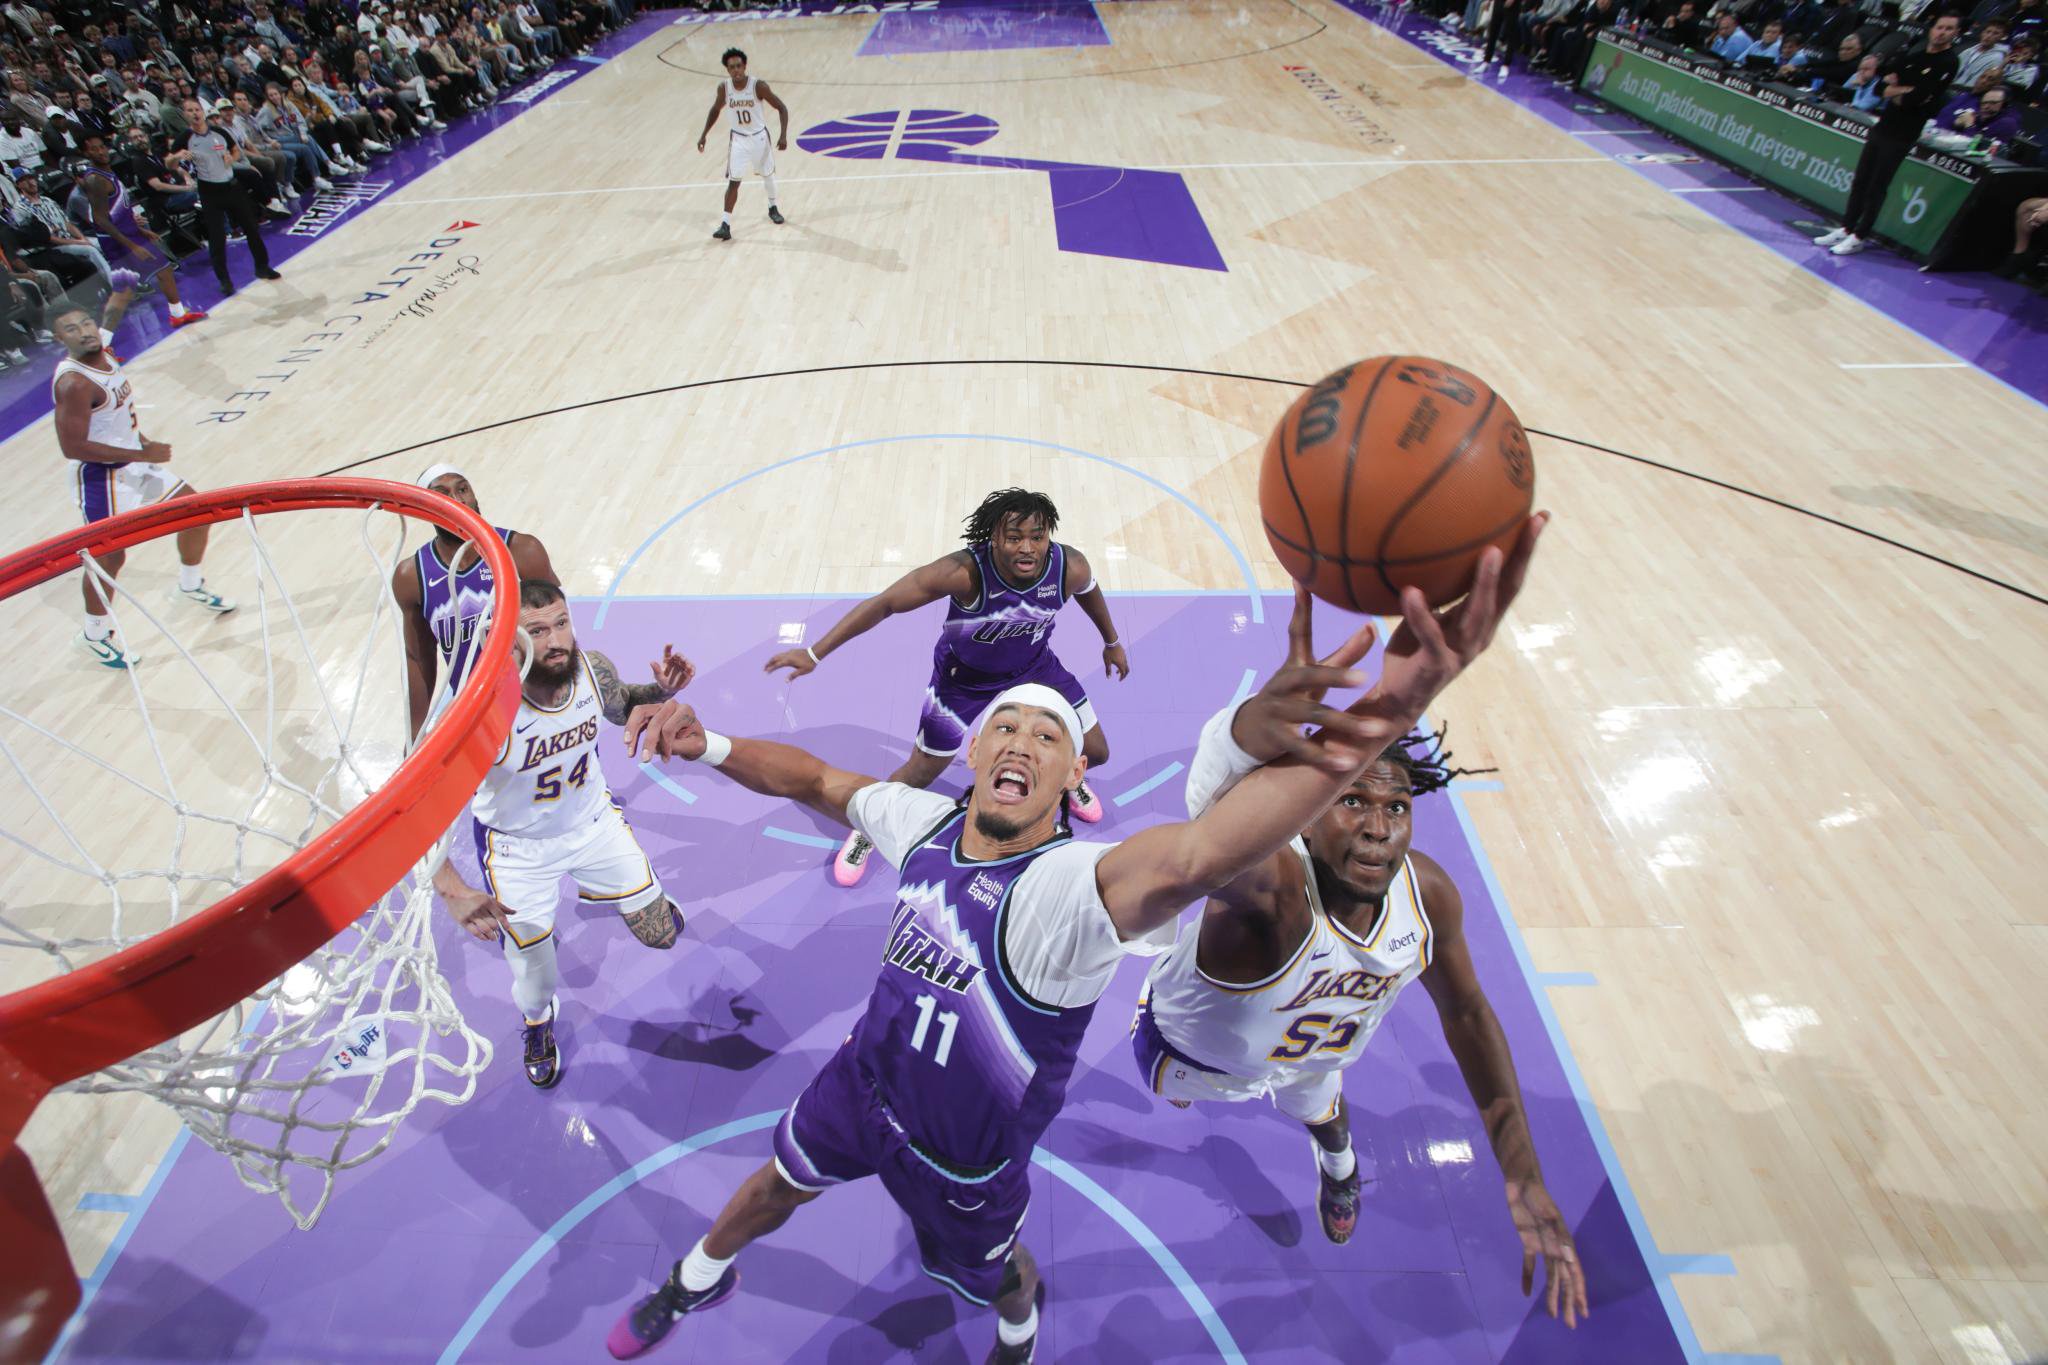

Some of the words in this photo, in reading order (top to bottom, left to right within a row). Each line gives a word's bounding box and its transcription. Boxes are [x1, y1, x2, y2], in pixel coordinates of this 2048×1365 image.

[673, 8, 801, 24] UTAH
[811, 1, 939, 16] JAZZ
[1673, 57, 1691, 70] DELTA
[1701, 66, 1721, 80] DELTA
[1735, 78, 1752, 92] DELTA
[729, 98, 754, 108] LAKERS
[1764, 91, 1787, 106] DELTA
[736, 109, 751, 125] 10
[1800, 106, 1826, 122] DELTA
[1619, 71, 1640, 96] An
[1638, 78, 1661, 106] HR
[1655, 90, 1717, 136] platform
[1719, 112, 1752, 147] that
[1751, 131, 1805, 170] never
[1803, 154, 1856, 192] miss
[1840, 120, 1870, 138] DELTA
[1940, 157, 1973, 176] DELTA
[353, 237, 462, 305] DELTA
[196, 315, 362, 426] CENTER
[1037, 583, 1057, 593] Health
[1037, 589, 1057, 599] Equity
[575, 695, 594, 711] Albert
[517, 714, 598, 773] LAKERS
[534, 751, 590, 803] 54
[974, 871, 1004, 895] Health
[967, 882, 998, 911] Equity
[881, 900, 984, 995] UTAH
[910, 993, 960, 1068] 11
